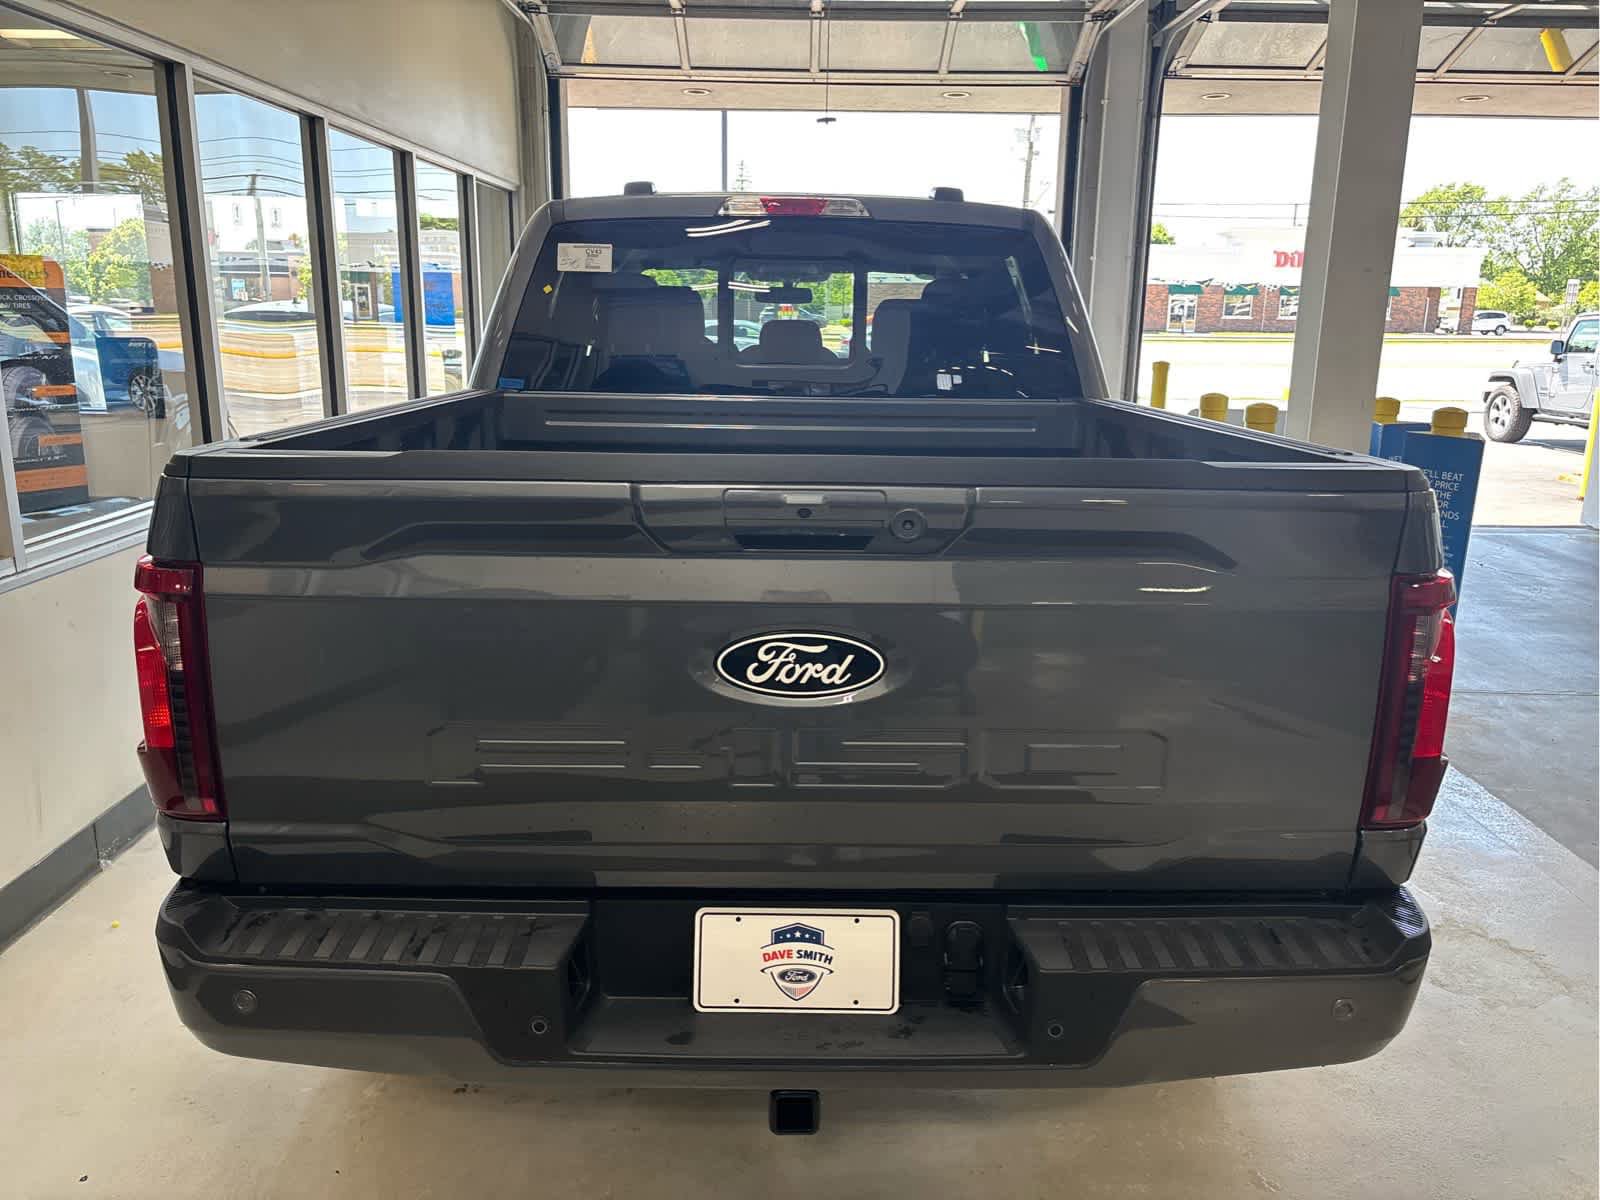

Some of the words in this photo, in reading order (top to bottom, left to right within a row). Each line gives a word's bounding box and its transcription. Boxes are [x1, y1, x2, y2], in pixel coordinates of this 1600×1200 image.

[1441, 471, 1464, 481] BEAT
[1435, 480, 1460, 491] PRICE
[1436, 490, 1452, 500] THE
[746, 642, 855, 684] Ford
[762, 949, 794, 962] DAVE
[796, 949, 833, 965] SMITH
[784, 969, 809, 981] Ford
